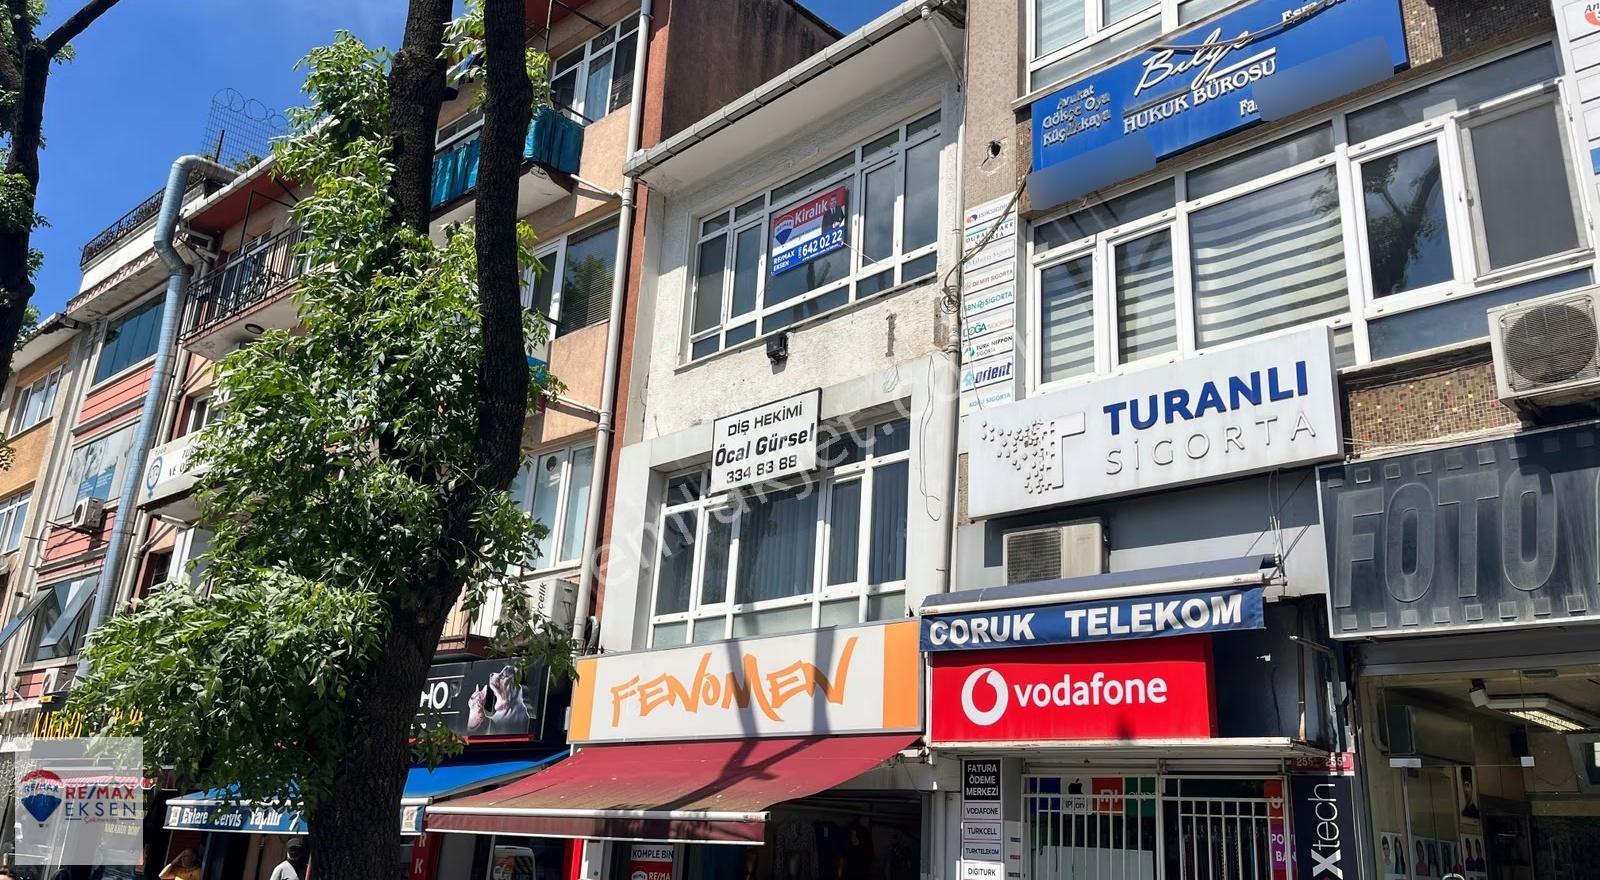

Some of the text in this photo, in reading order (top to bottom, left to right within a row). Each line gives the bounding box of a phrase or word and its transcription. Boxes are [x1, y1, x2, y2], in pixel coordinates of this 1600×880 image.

[1123, 58, 1277, 135] HUKUK BÜROSU
[794, 199, 828, 226] Kiralık
[802, 240, 818, 256] 642
[820, 235, 830, 249] 02
[831, 229, 843, 243] 22
[975, 362, 1012, 384] orient
[1103, 360, 1309, 436] TURANLI
[727, 400, 803, 437] DİŞ HEKİMİ
[714, 422, 815, 467] Öcal Gürsel
[1104, 410, 1316, 477] SİGORTA
[726, 454, 798, 484] 334 83 88
[1334, 465, 1558, 609] FOTO
[929, 593, 1244, 646] CORUK TELEKOM
[610, 636, 859, 728] FENOMEN
[1013, 671, 1168, 708] vodafone
[967, 764, 997, 774] FATURA
[968, 774, 996, 785] ÖDEME
[966, 786, 999, 797] MERKEZİ
[182, 807, 209, 825] Evlere
[966, 807, 999, 815] VODAFONE
[967, 827, 998, 836] TURKCELL
[632, 849, 660, 859] KOMPLE
[648, 871, 671, 880] RE/MA
[967, 867, 997, 877] DIGITURK
